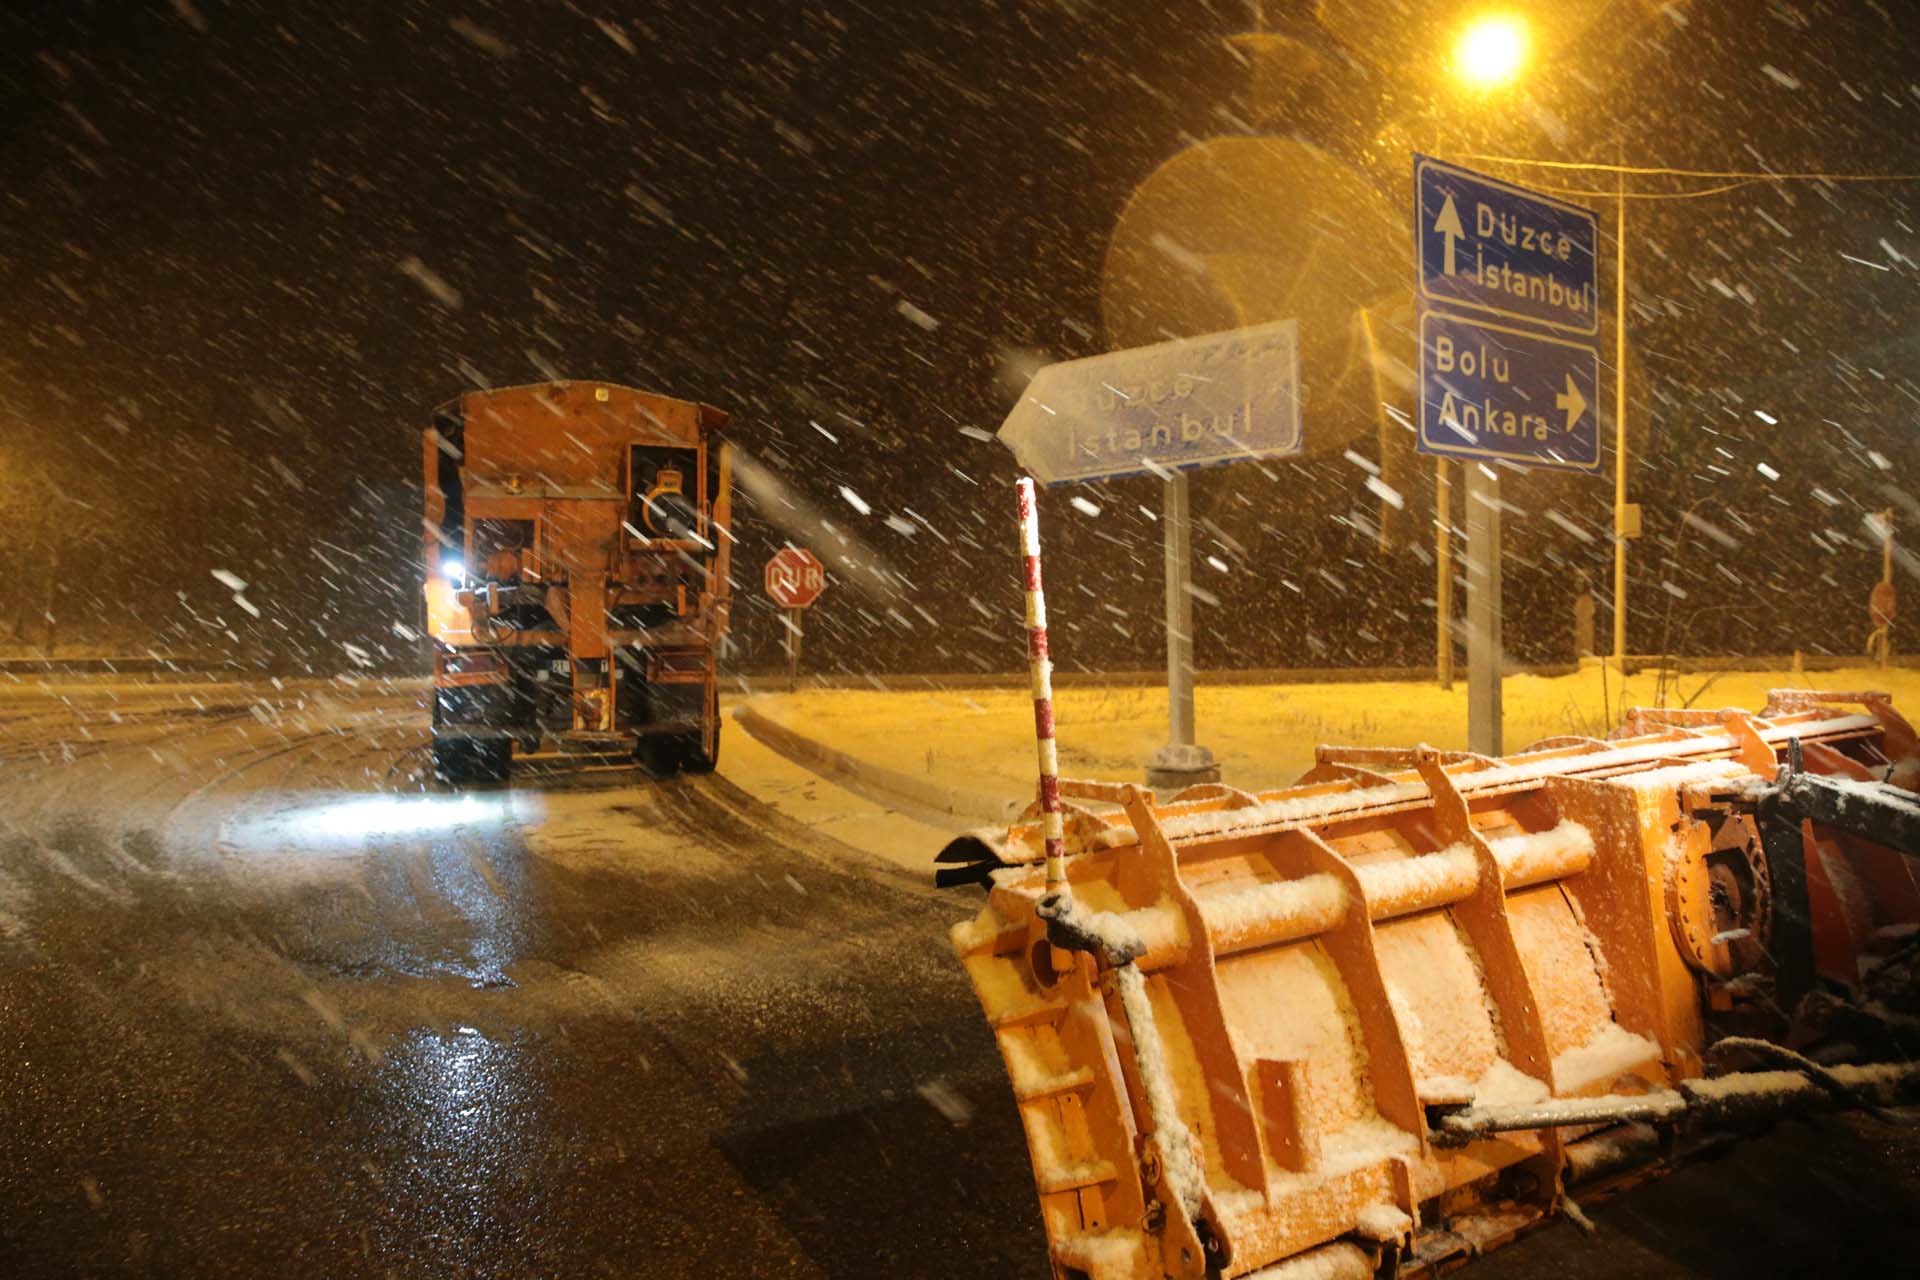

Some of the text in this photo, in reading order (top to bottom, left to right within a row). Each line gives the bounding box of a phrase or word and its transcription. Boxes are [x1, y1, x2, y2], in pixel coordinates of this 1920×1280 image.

[1477, 202, 1571, 261] Düzce
[1477, 242, 1589, 313] İstanbul
[1436, 336, 1509, 383] Bolu
[1438, 392, 1548, 440] Ankara
